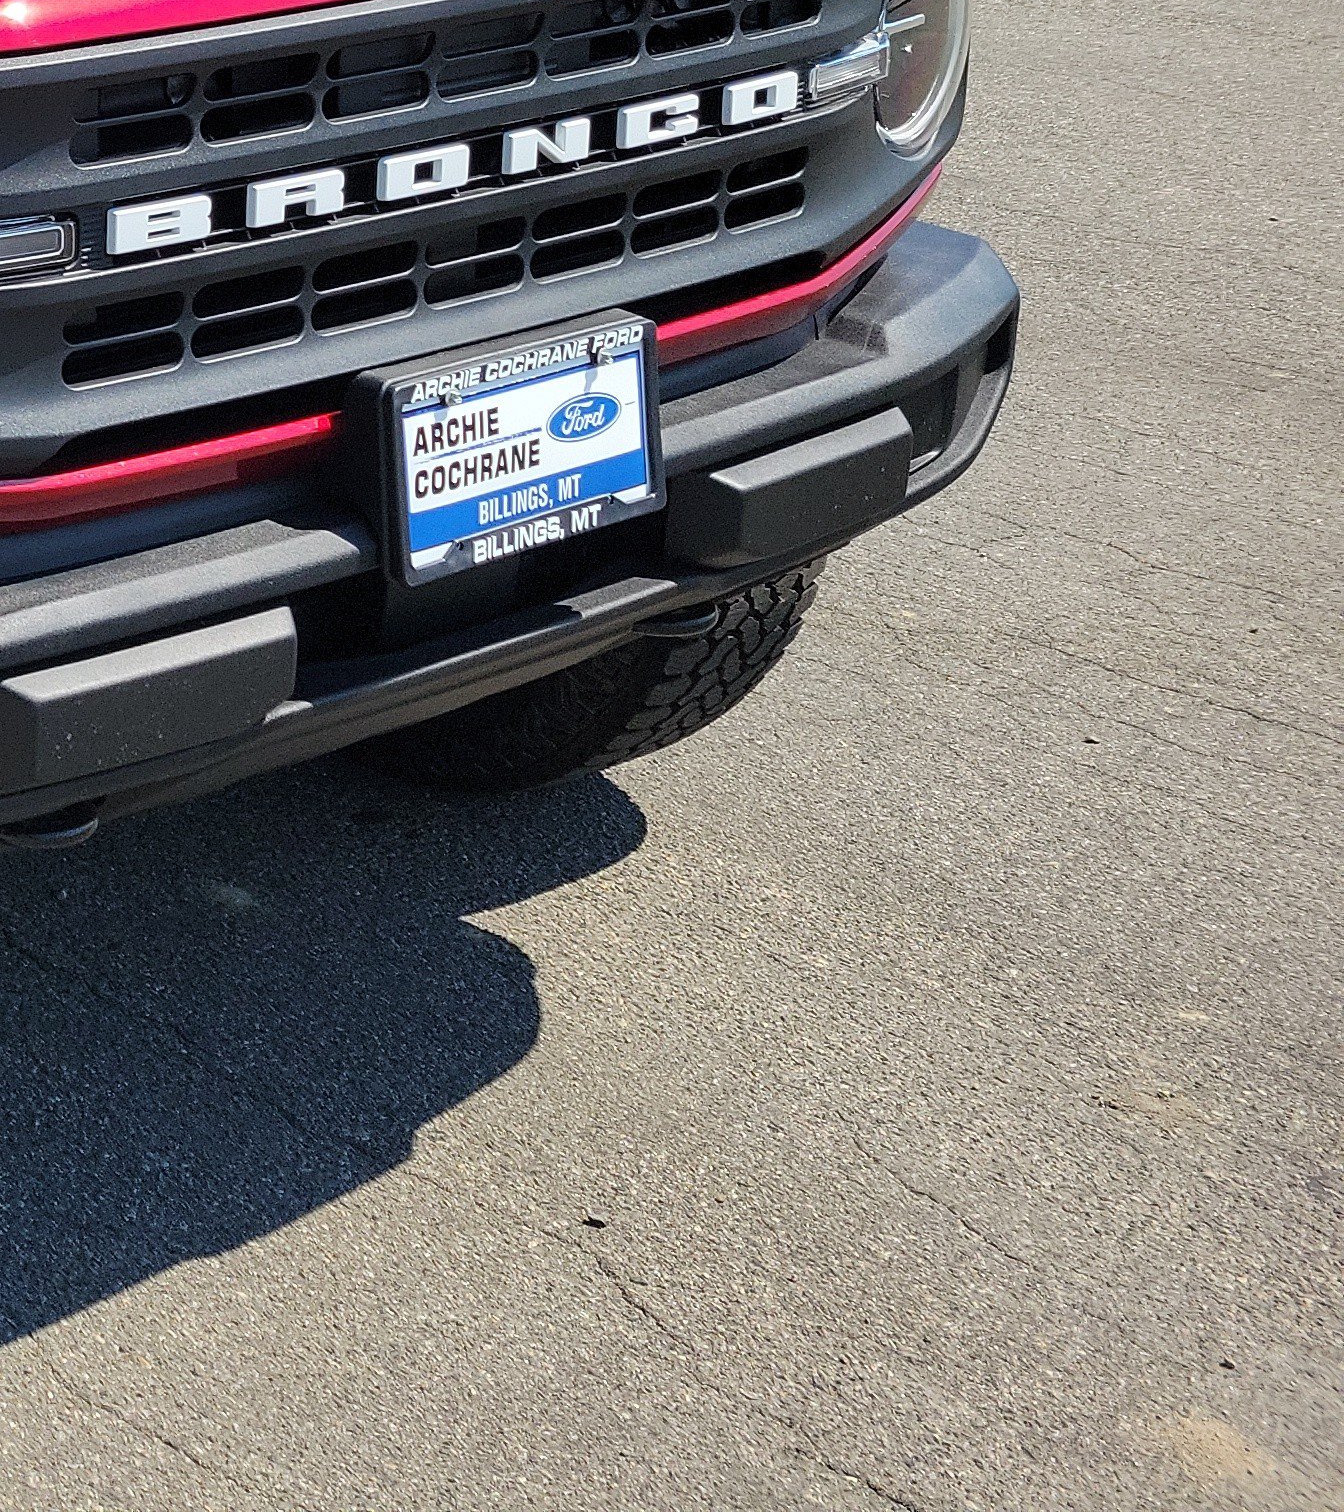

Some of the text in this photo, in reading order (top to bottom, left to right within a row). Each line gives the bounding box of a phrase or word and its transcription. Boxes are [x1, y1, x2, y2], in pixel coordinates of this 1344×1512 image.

[106, 70, 799, 256] BRONCO
[410, 324, 644, 403] ARCHIE COCHRANE FORD
[413, 406, 500, 456] ARCHIE
[560, 400, 605, 436] Ford
[414, 438, 541, 499] COCHRANE
[478, 473, 582, 526] BILLINGS, MT
[473, 504, 602, 564] BILLINGS, MT
